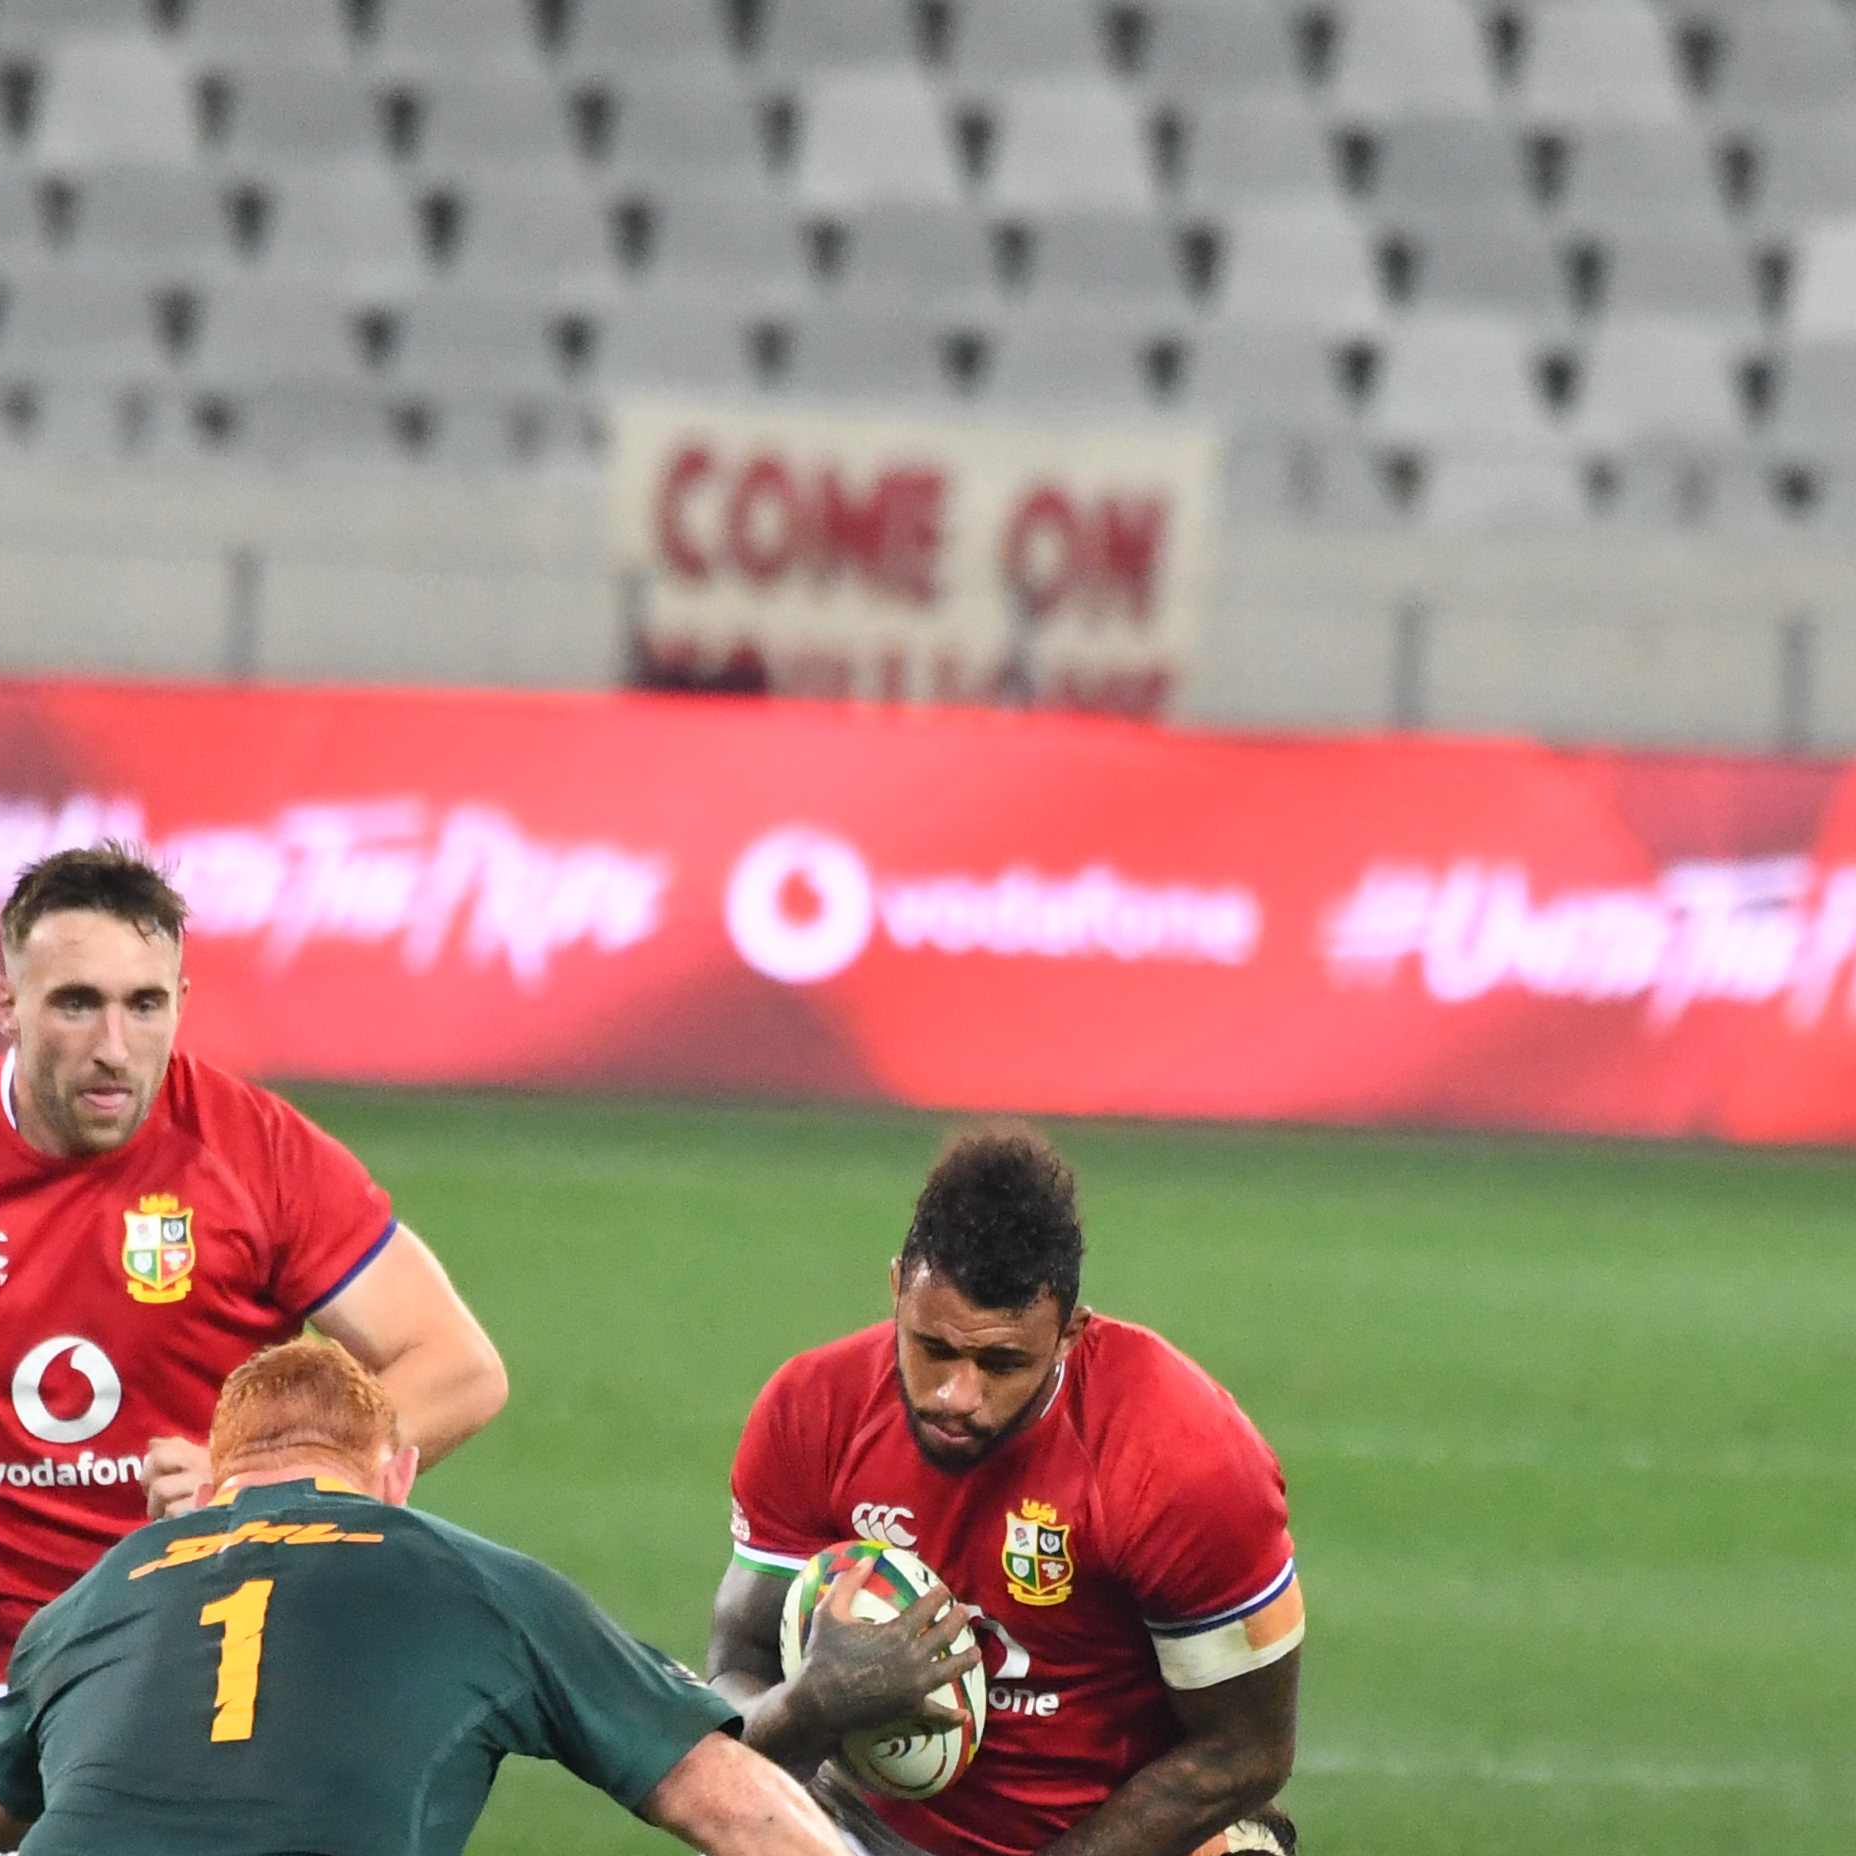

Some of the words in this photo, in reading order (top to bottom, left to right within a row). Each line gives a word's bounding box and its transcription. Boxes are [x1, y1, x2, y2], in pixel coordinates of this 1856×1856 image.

[656, 448, 944, 608] COME
[999, 484, 1169, 616] ON
[876, 862, 1260, 965] vodafone
[200, 1580, 274, 1742] 1
